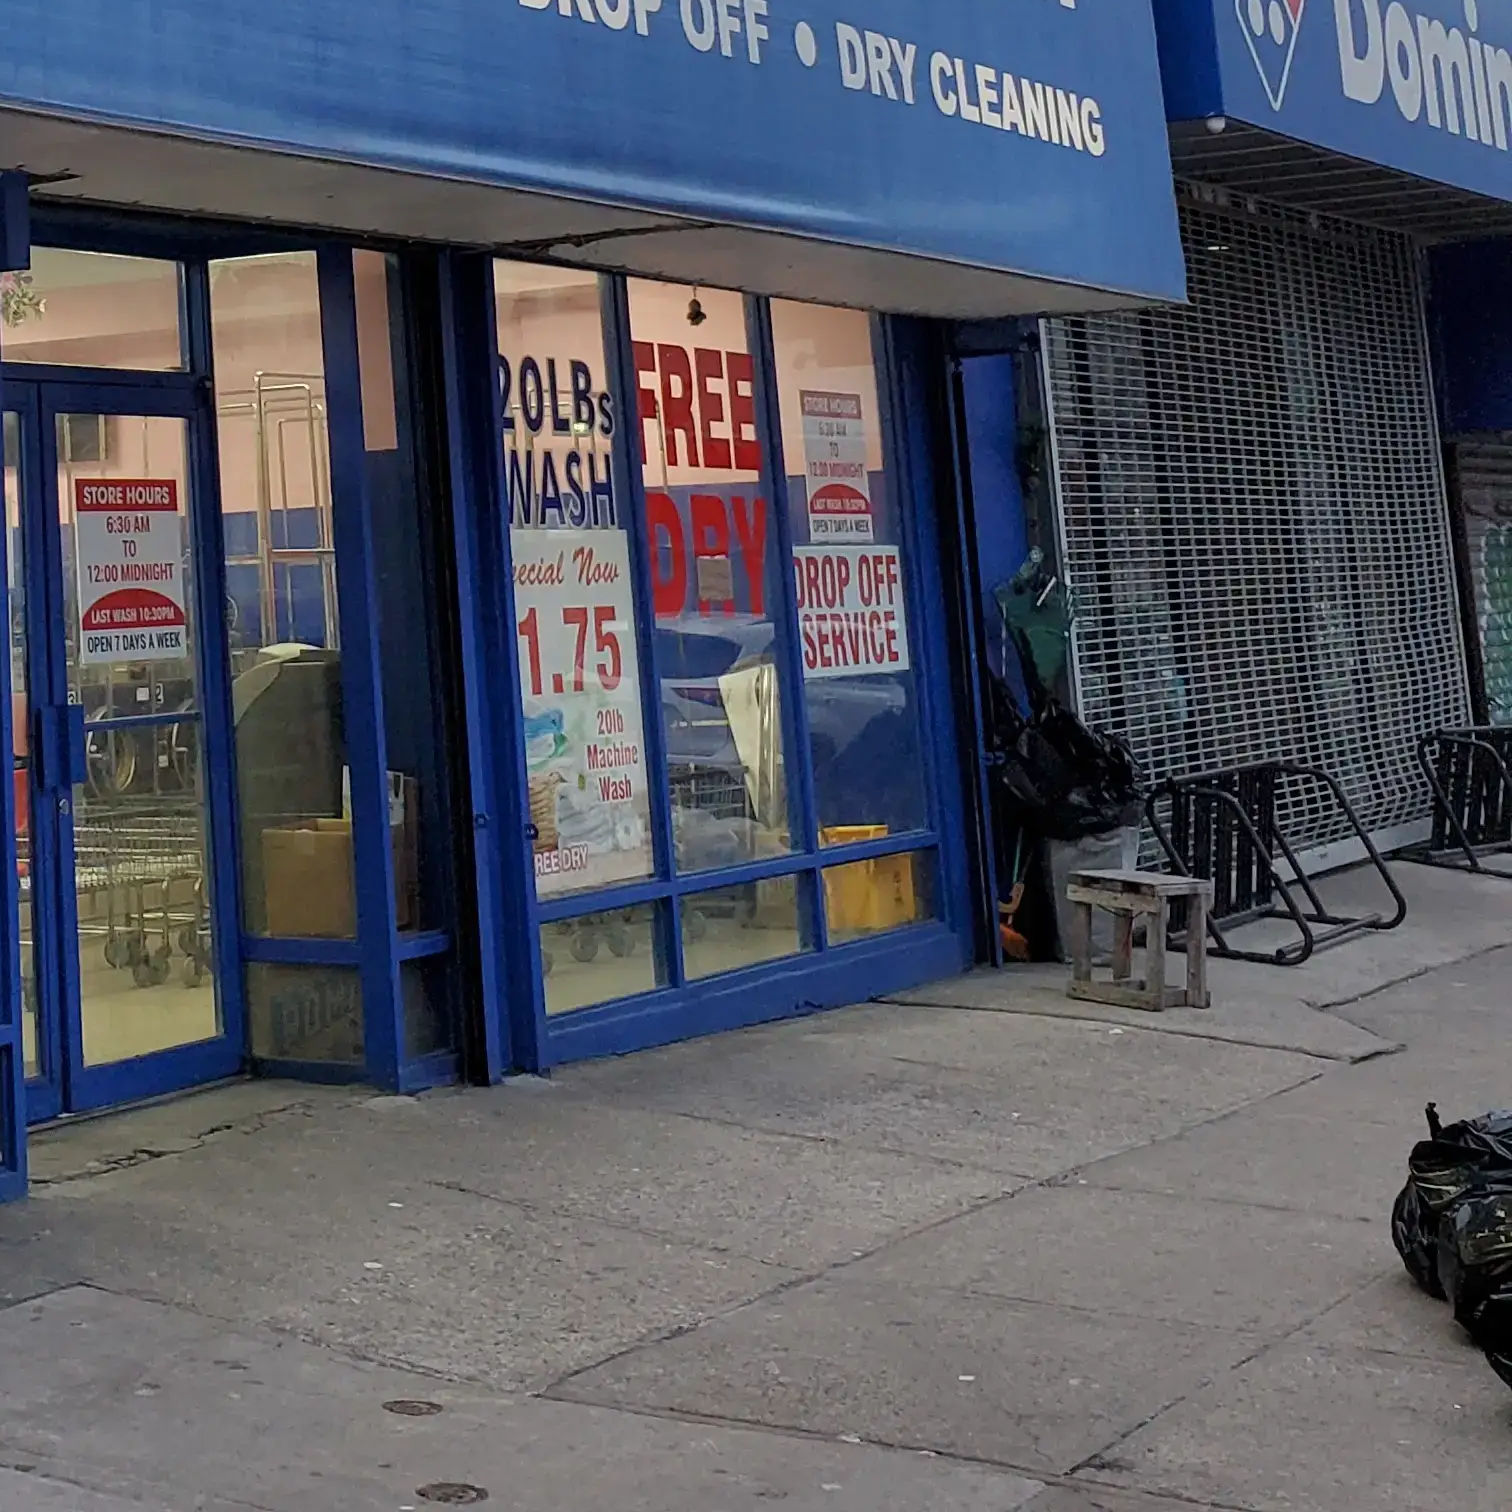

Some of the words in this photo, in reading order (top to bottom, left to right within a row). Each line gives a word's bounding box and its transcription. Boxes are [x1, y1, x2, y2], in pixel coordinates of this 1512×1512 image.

[836, 21, 916, 104] DRY
[930, 51, 1106, 157] CLEANING
[632, 341, 762, 470] FREE
[83, 486, 123, 505] STORE
[126, 486, 170, 505] HOURS
[106, 516, 130, 534] 6:30
[133, 516, 150, 533] AM
[122, 540, 137, 557] TO
[645, 492, 767, 618] DRY
[88, 564, 118, 583] 12:00
[120, 563, 174, 582] MIDNIGHT
[512, 550, 565, 586] ecial
[572, 545, 620, 586] Now
[793, 554, 850, 609] DROP
[858, 554, 898, 607] OFF
[91, 610, 111, 625] LAST
[112, 609, 137, 623] WASH
[88, 635, 112, 653] OPEN
[114, 634, 120, 652] 7
[122, 633, 146, 651] DAYS
[148, 632, 155, 649] A
[157, 630, 181, 648] WEEK
[518, 605, 622, 696] 1.75
[802, 610, 900, 670] SERVICE
[597, 708, 624, 736] 20lb
[587, 743, 639, 770] Machine
[598, 777, 632, 802] Wash
[561, 844, 589, 872] DRY
